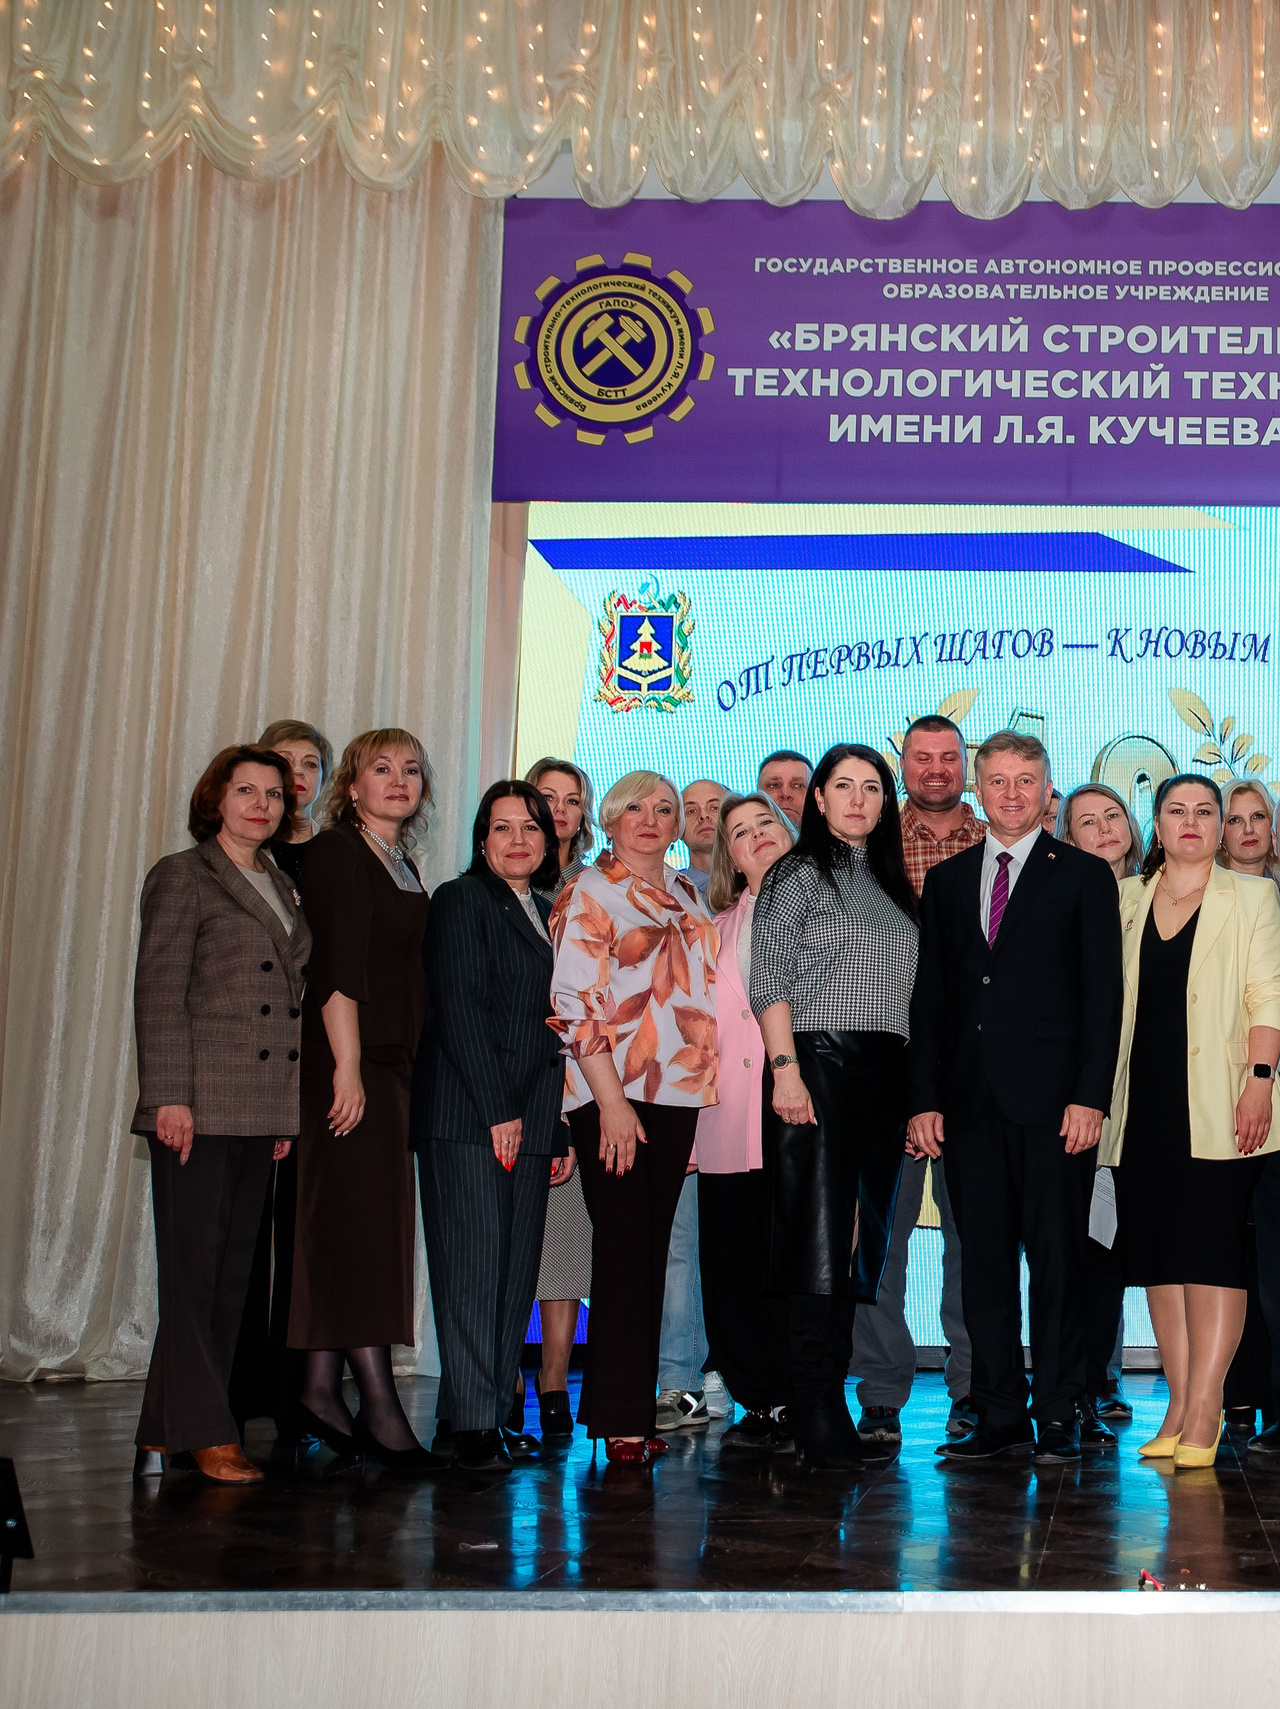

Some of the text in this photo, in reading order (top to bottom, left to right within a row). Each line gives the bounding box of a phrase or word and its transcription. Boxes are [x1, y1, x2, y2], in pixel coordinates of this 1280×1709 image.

[754, 257, 978, 276] ГОСУДАРСТВЕННОЕ
[983, 258, 1142, 276] АВТОНОМНОЕ
[598, 299, 637, 309] ГАПОУ
[648, 288, 681, 326] техникум
[882, 283, 1269, 304] ОБРАЗОВАТЕЛЬНОЕ УЧРЕЖДЕНИЕ
[543, 280, 646, 374] строительно-технологический
[677, 327, 686, 359] имени
[768, 316, 1029, 353] «БРЯНСКИЙ
[548, 375, 587, 412] Брянский
[596, 388, 628, 398] БСТТ
[727, 363, 1170, 401] ТЕХНОЛОГИЧЕСКИЙ
[829, 413, 982, 444] ИМЕНИ
[993, 415, 1076, 445] Л.Я.
[717, 655, 775, 712] ОТ
[781, 632, 929, 688] ПЕРВЫХ
[933, 627, 1054, 667] ШАГОВ
[1107, 628, 1134, 664] К
[1136, 626, 1271, 664] НОВЫМ
